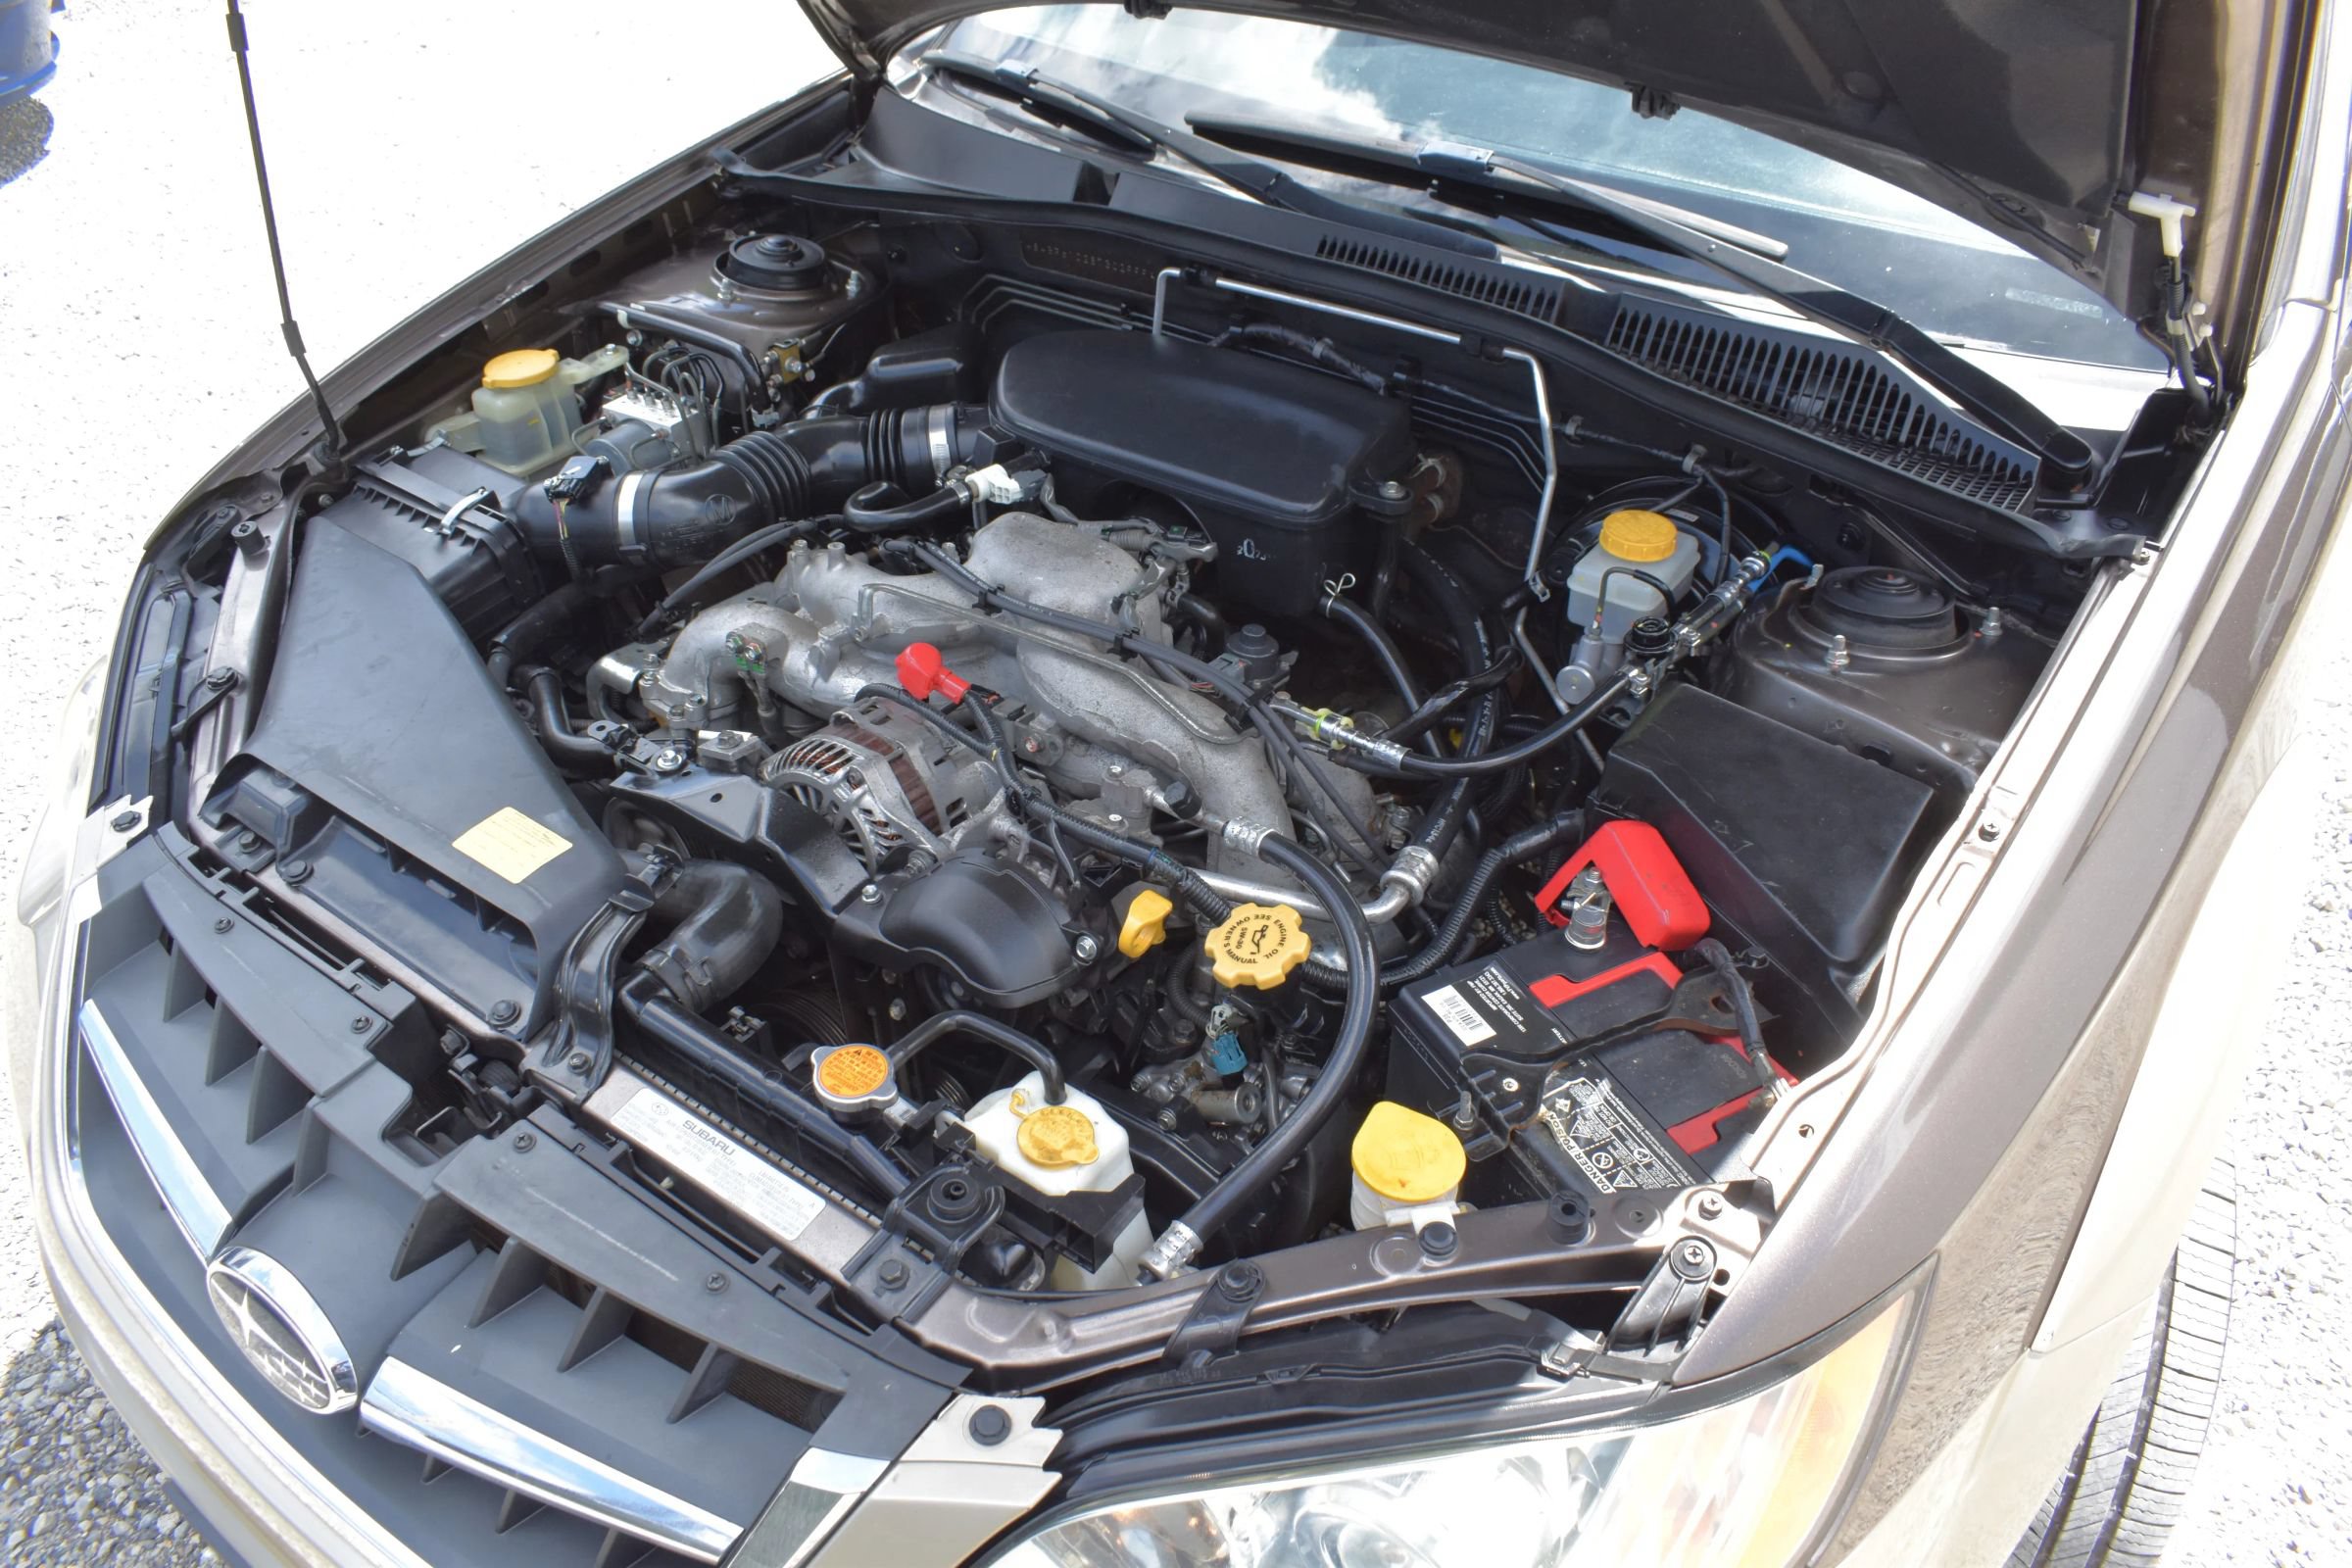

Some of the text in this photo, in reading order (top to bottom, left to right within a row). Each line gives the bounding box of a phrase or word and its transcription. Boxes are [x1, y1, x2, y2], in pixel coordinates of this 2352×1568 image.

[1226, 949, 1257, 963] MANUAL
[1263, 919, 1287, 958] ENGINE OIL
[682, 1119, 736, 1155] SUBARU
